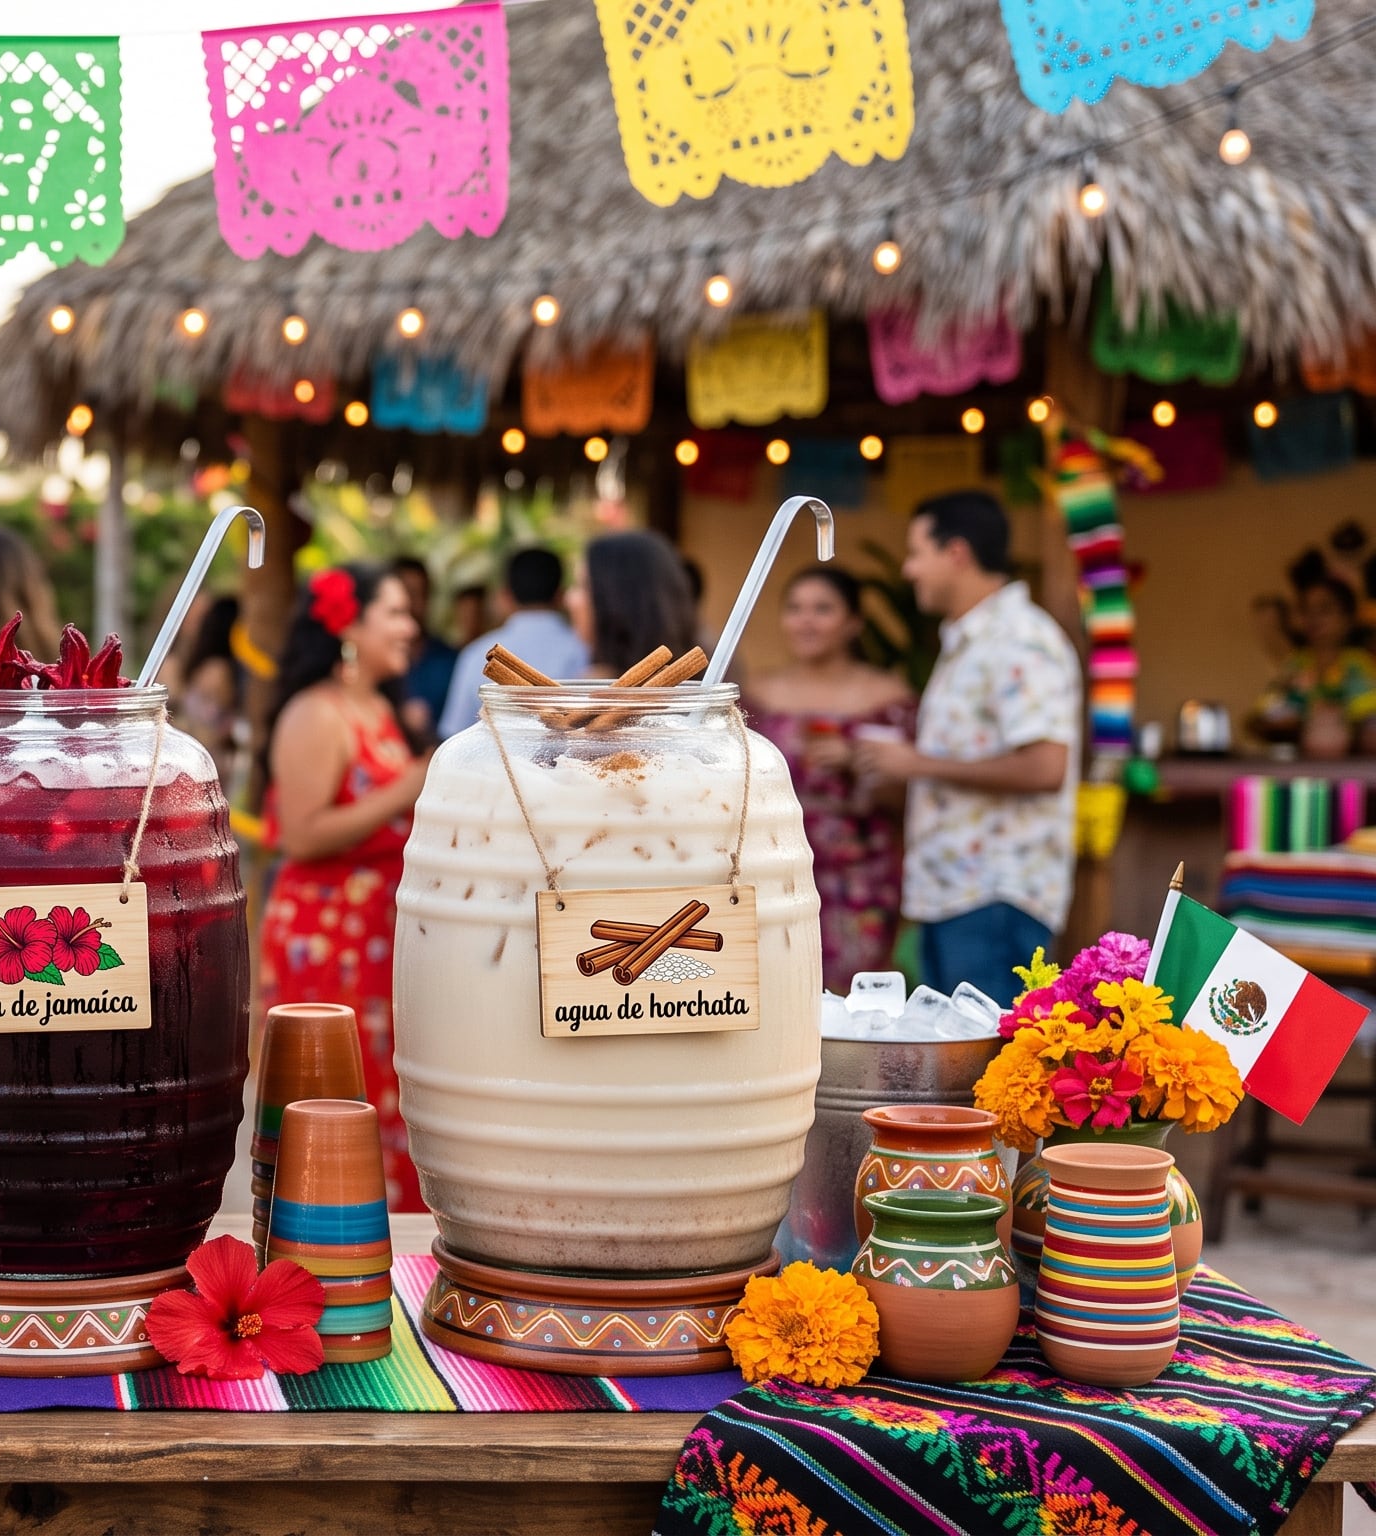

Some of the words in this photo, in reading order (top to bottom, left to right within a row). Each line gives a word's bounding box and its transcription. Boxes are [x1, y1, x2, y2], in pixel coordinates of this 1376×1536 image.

[11, 989, 40, 1017] de
[554, 1004, 613, 1031] agua
[617, 992, 645, 1020] de
[649, 989, 750, 1018] horchata
